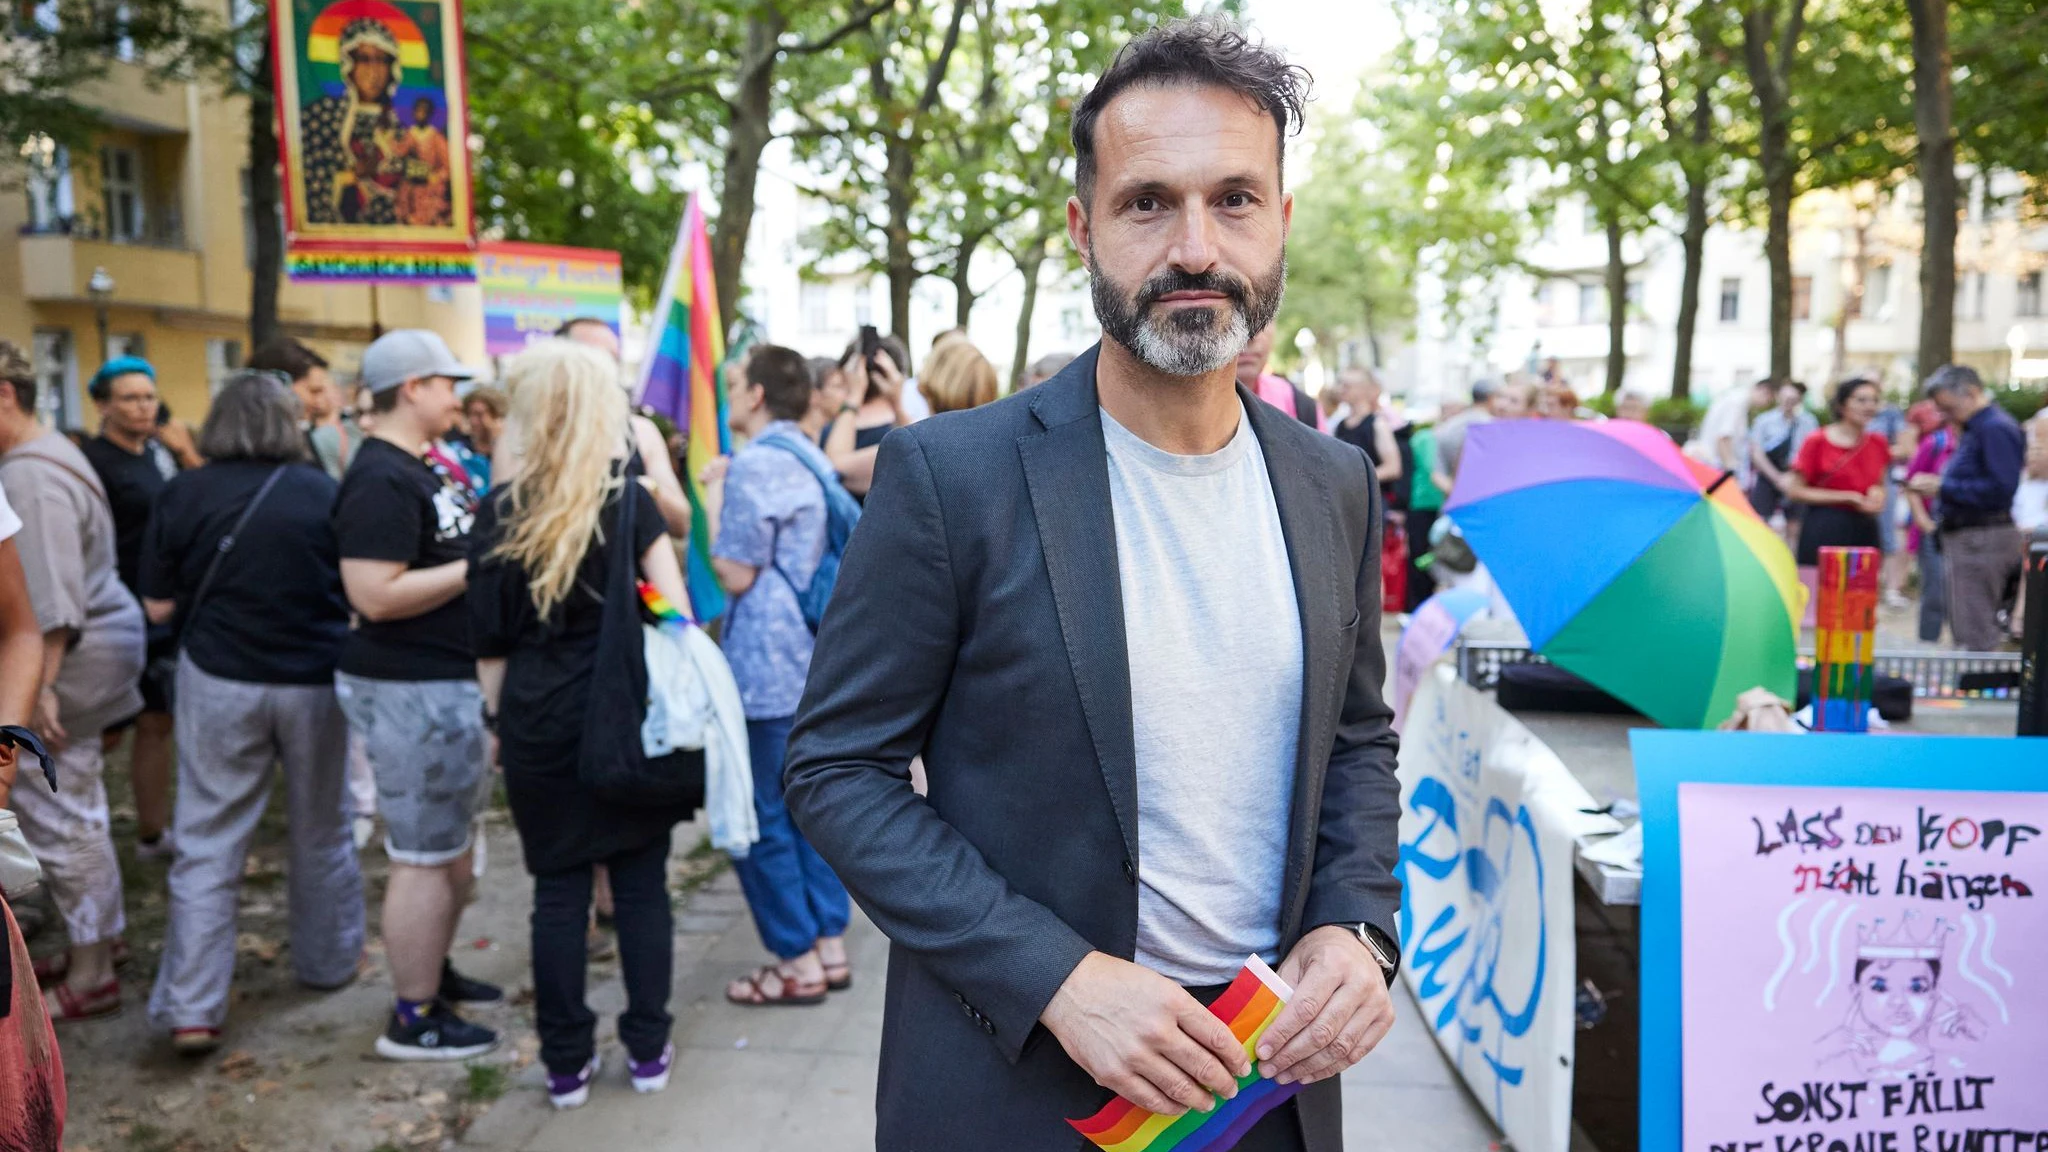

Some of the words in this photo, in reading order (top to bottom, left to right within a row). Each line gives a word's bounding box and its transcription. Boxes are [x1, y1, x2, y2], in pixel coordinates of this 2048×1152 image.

[1752, 806, 1843, 855] LASS
[1855, 822, 1902, 845] DEN
[1917, 806, 2041, 856] KOPF
[1896, 858, 2034, 910] hängen
[1755, 1082, 1868, 1124] SONST
[1871, 1071, 1995, 1118] FÄLLT
